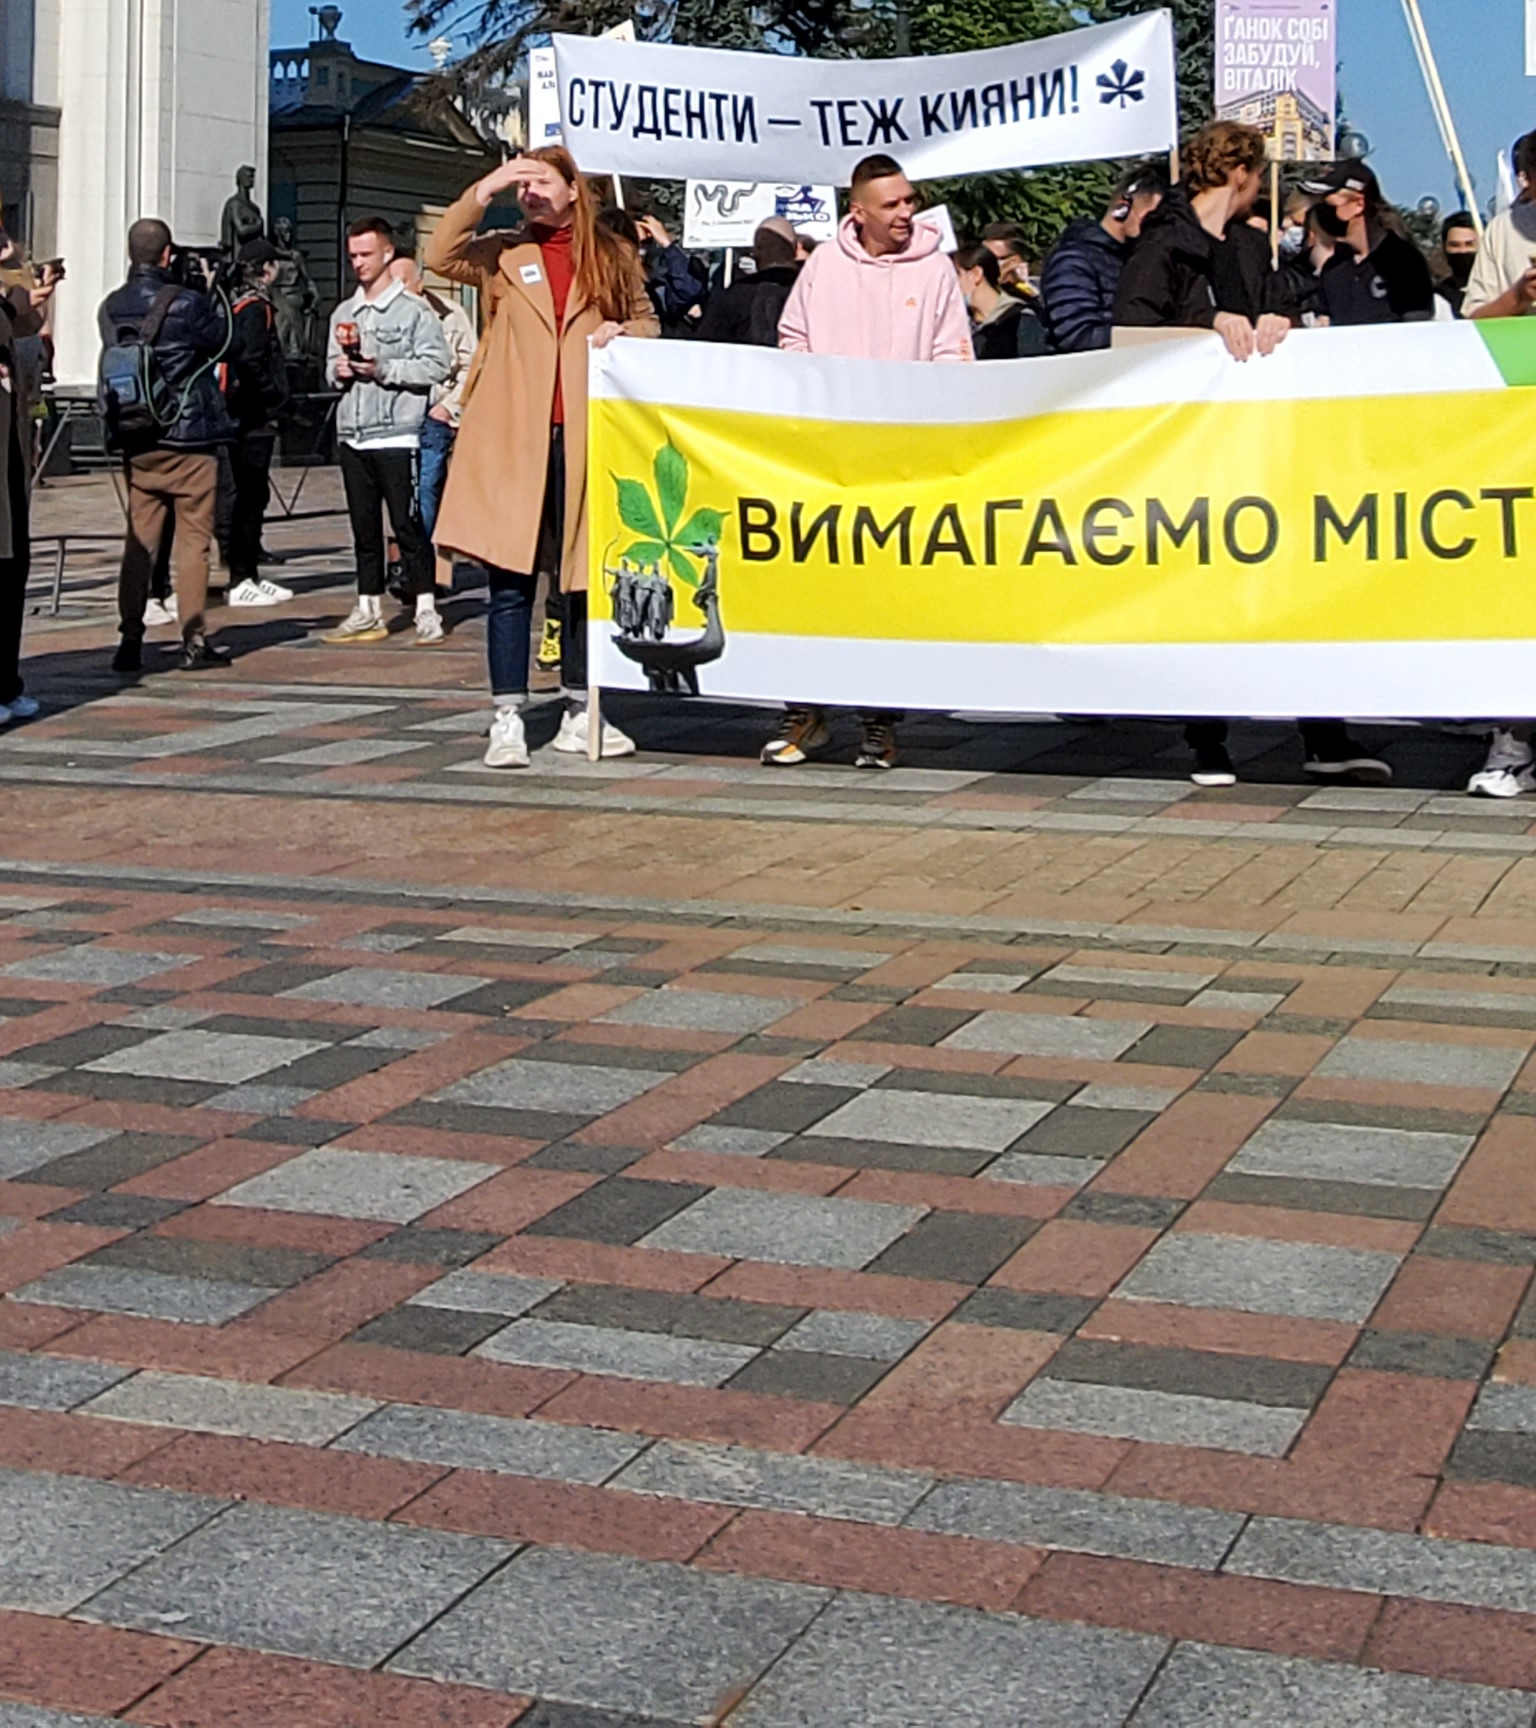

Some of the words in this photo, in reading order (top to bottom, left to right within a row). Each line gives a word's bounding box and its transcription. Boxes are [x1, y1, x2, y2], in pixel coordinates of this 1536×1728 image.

[1224, 15, 1283, 41] ҐАНОК
[1287, 16, 1329, 42] СОБІ
[1223, 40, 1322, 70] ЗАБУДУЙ,
[1224, 66, 1298, 92] ВІТАЛІК
[569, 78, 758, 144] СТУДЕНТИ
[809, 97, 910, 147] ТЕЖ
[919, 64, 1079, 138] КИЯНИ!
[738, 496, 1278, 566] ВИМАГАЄМО
